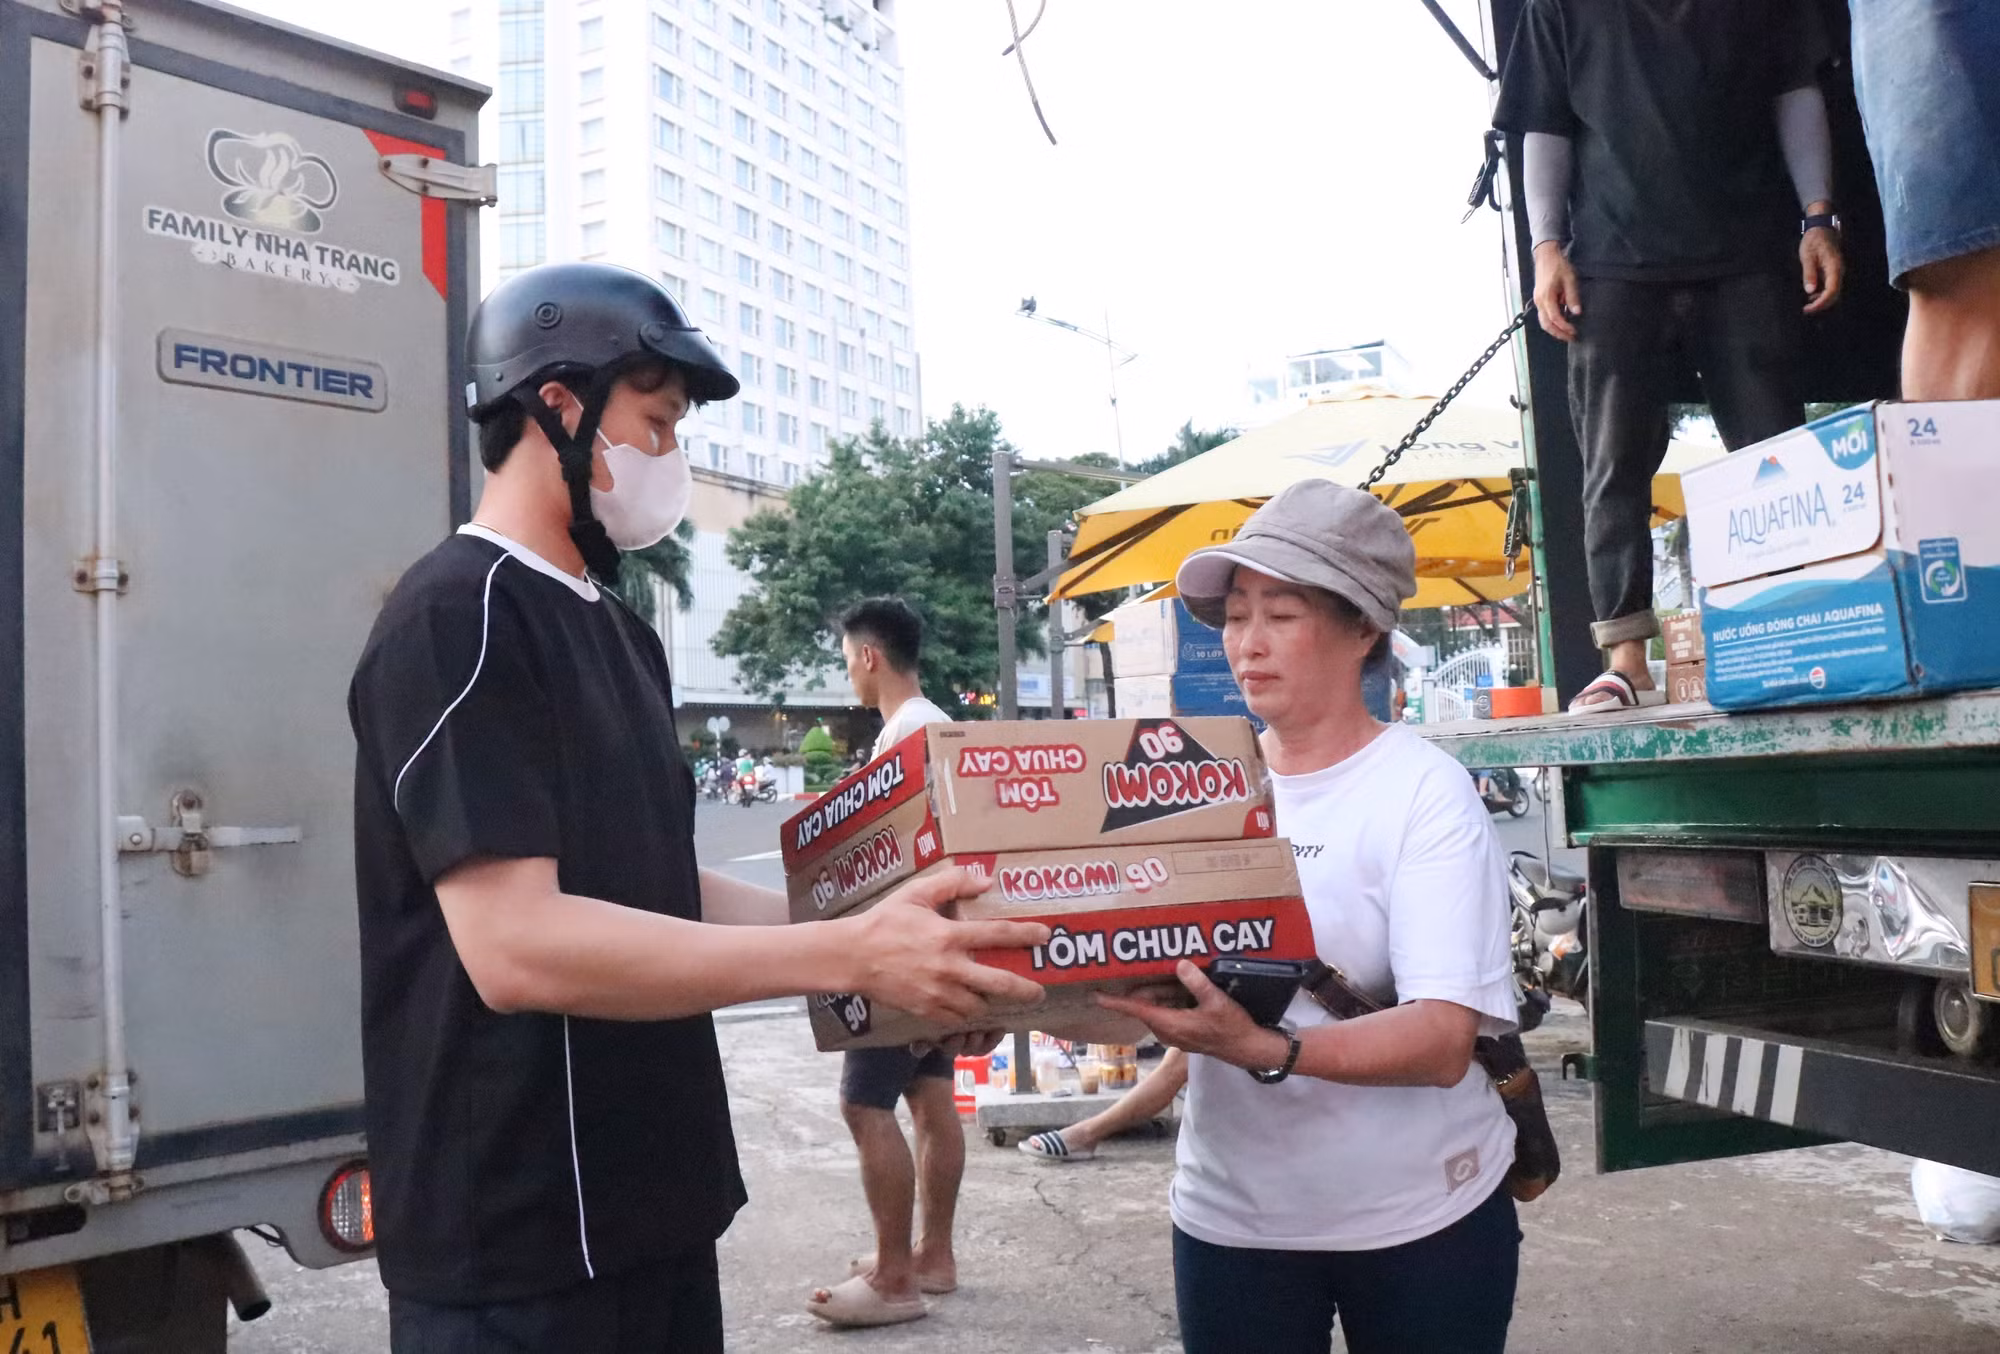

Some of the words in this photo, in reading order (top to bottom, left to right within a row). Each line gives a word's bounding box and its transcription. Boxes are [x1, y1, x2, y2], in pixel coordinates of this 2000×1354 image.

[147, 207, 249, 248] FAMILY
[255, 232, 309, 262] NHA
[315, 245, 396, 281] TRANG
[223, 252, 330, 285] BAKERY
[174, 343, 373, 399] FRONTIER
[1907, 417, 1937, 436] 24
[1842, 481, 1865, 504] 24
[1728, 482, 1831, 554] AQUAFINA
[1796, 613, 1821, 628] CHAI
[1824, 603, 1883, 622] AQUAFINA
[1014, 749, 1083, 770] CHUA
[1138, 725, 1184, 760] 90
[867, 754, 904, 799] TÔM
[961, 751, 1010, 773] CAY
[1000, 780, 1056, 810] TÔM
[1104, 758, 1248, 808] KOKOMI
[825, 782, 865, 829] CHUA
[797, 816, 822, 850] CAY
[834, 825, 904, 897] KOKOMI
[999, 859, 1120, 901] KOKOMI
[1126, 857, 1169, 894] 90
[812, 870, 835, 910] 90
[1032, 928, 1105, 969] TÔM
[1112, 925, 1207, 962] CHUA
[1212, 919, 1274, 953] CAY
[845, 995, 867, 1031] 90
